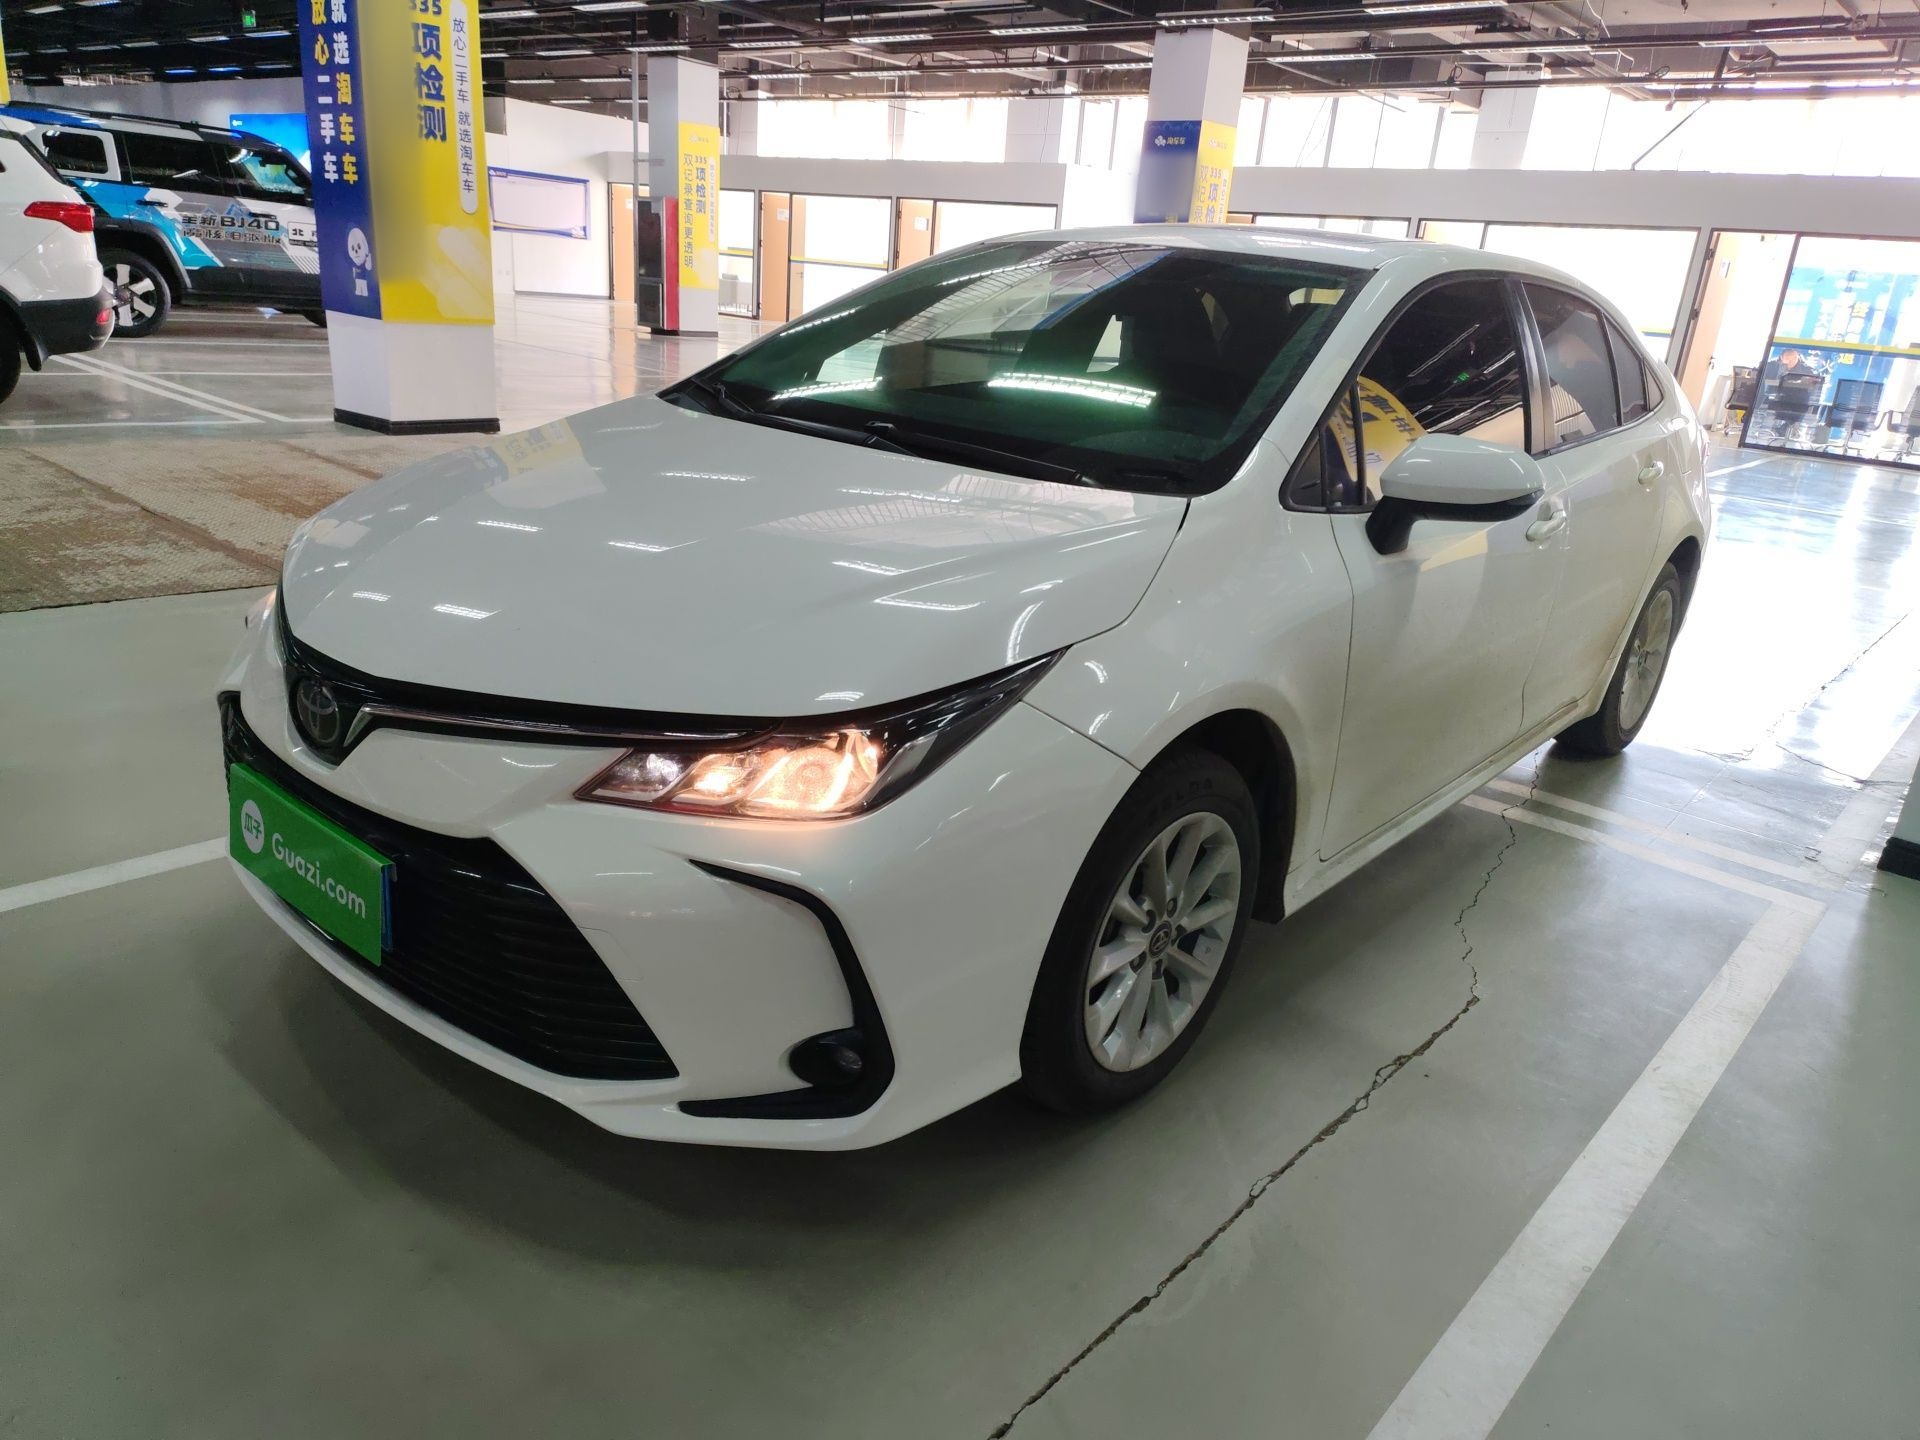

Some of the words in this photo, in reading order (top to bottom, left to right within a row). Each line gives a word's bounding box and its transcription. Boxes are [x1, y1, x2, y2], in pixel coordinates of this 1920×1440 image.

[331, 0, 358, 184] 就选淘车车
[411, 22, 447, 142] 项检测
[452, 18, 469, 103] 放心二手车
[458, 111, 474, 193] 就选淘车车
[696, 167, 706, 214] 项检测
[244, 812, 262, 840] 瓜子
[272, 832, 366, 919] Guazi.com
